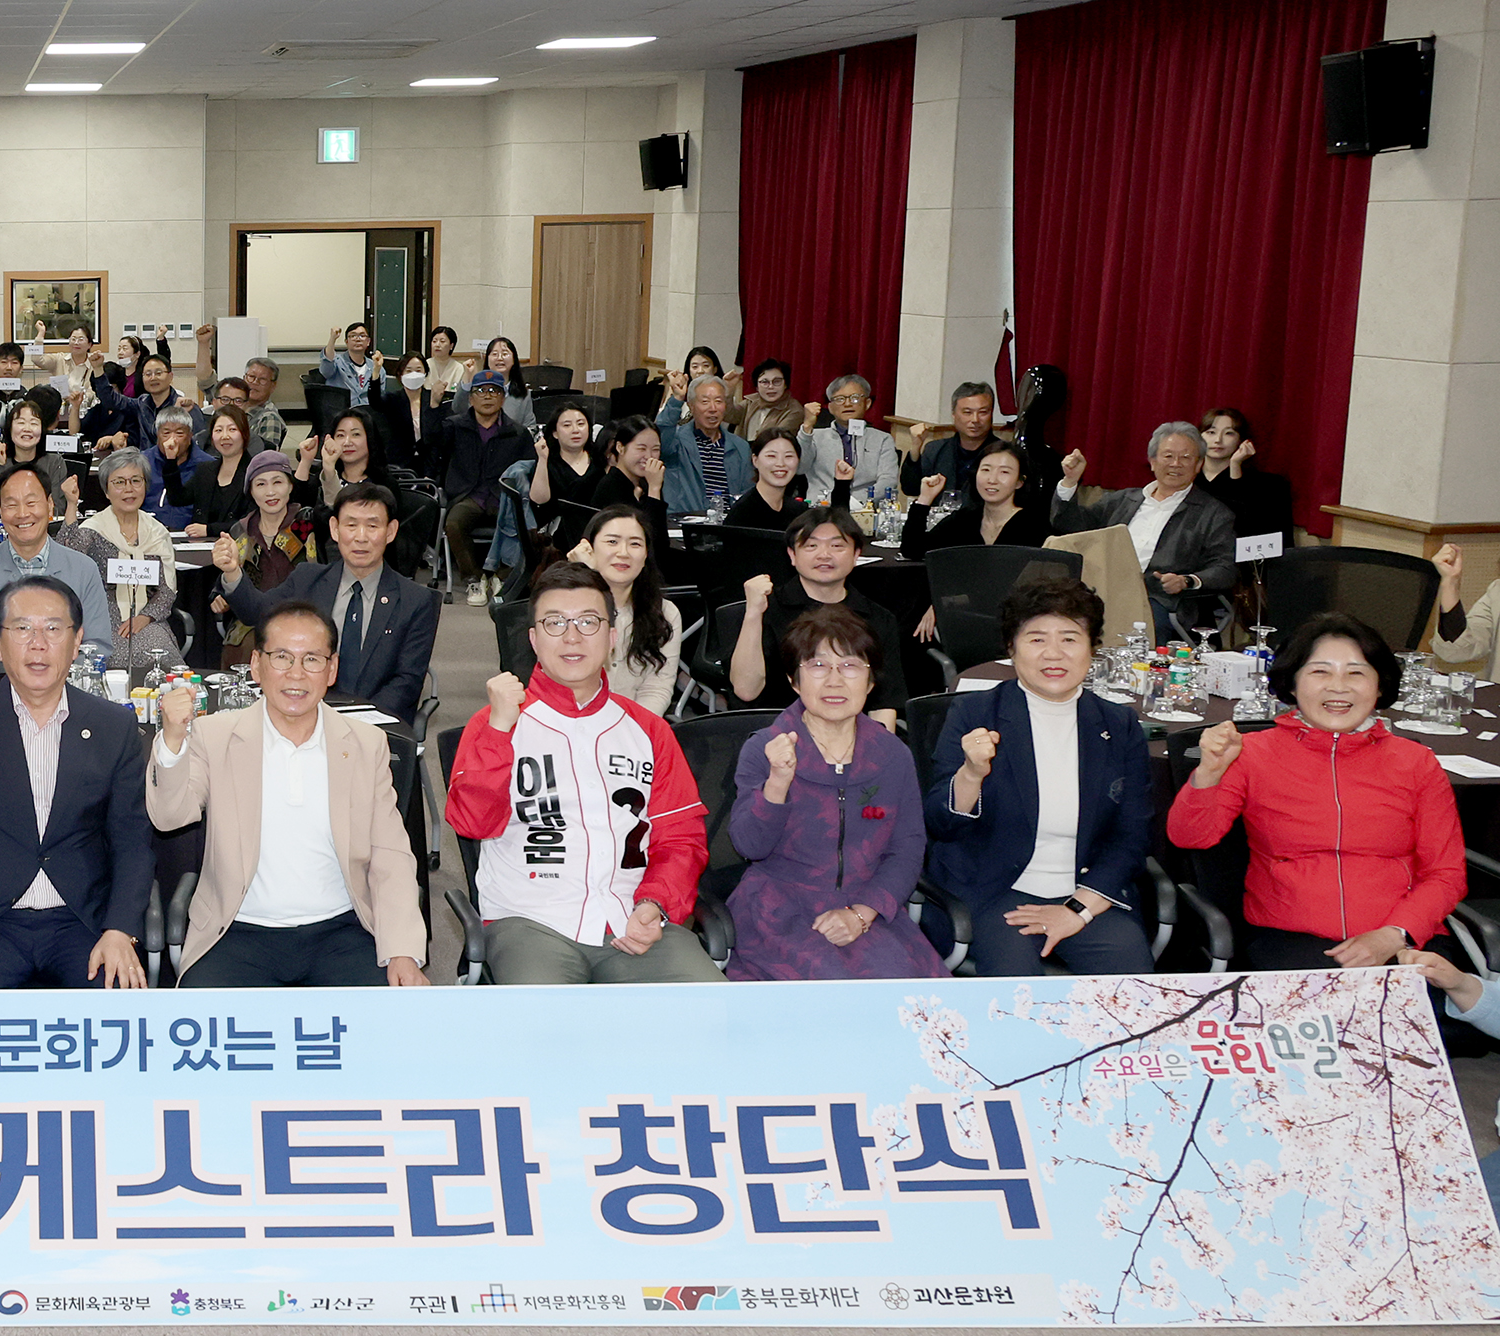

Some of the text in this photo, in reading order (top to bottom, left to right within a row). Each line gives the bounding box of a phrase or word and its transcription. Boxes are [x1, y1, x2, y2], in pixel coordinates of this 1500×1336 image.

[611, 786, 650, 869] 2
[169, 1016, 276, 1072] 있는
[294, 1016, 348, 1071] 날
[1093, 1053, 1187, 1079] 수요일은
[589, 1101, 1041, 1236] 창단식
[35, 1295, 152, 1312] 문화체육관광부
[194, 1297, 247, 1311] 충청북도
[310, 1296, 376, 1311] 괴산군
[523, 1294, 626, 1310] 지역문화진흥원
[740, 1286, 860, 1309] 충북문화재단
[913, 1285, 1015, 1306] 괴산문화원
